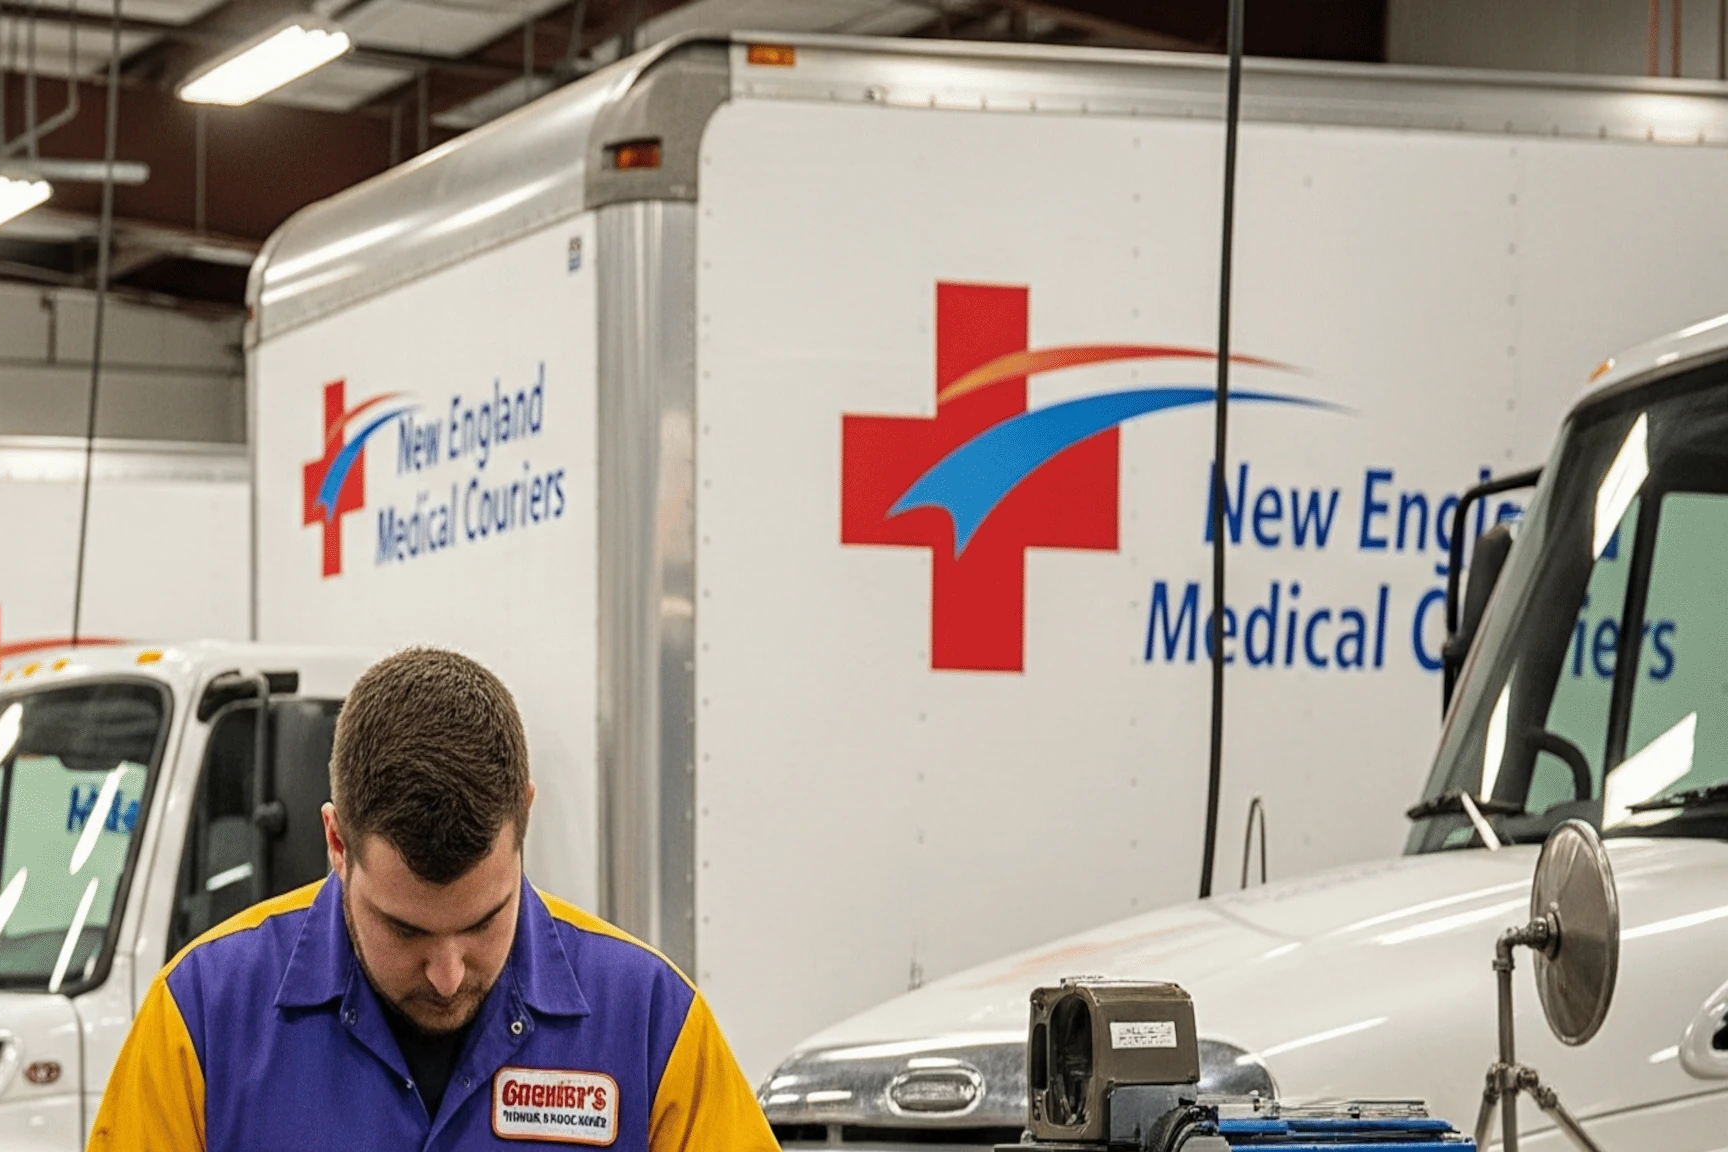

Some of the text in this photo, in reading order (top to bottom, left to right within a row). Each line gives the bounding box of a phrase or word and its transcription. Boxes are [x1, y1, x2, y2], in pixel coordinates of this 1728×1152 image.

[398, 361, 546, 476] New England
[375, 461, 565, 565] Medical Couriers
[1204, 460, 1340, 549] New
[1144, 579, 1390, 670] Medical
